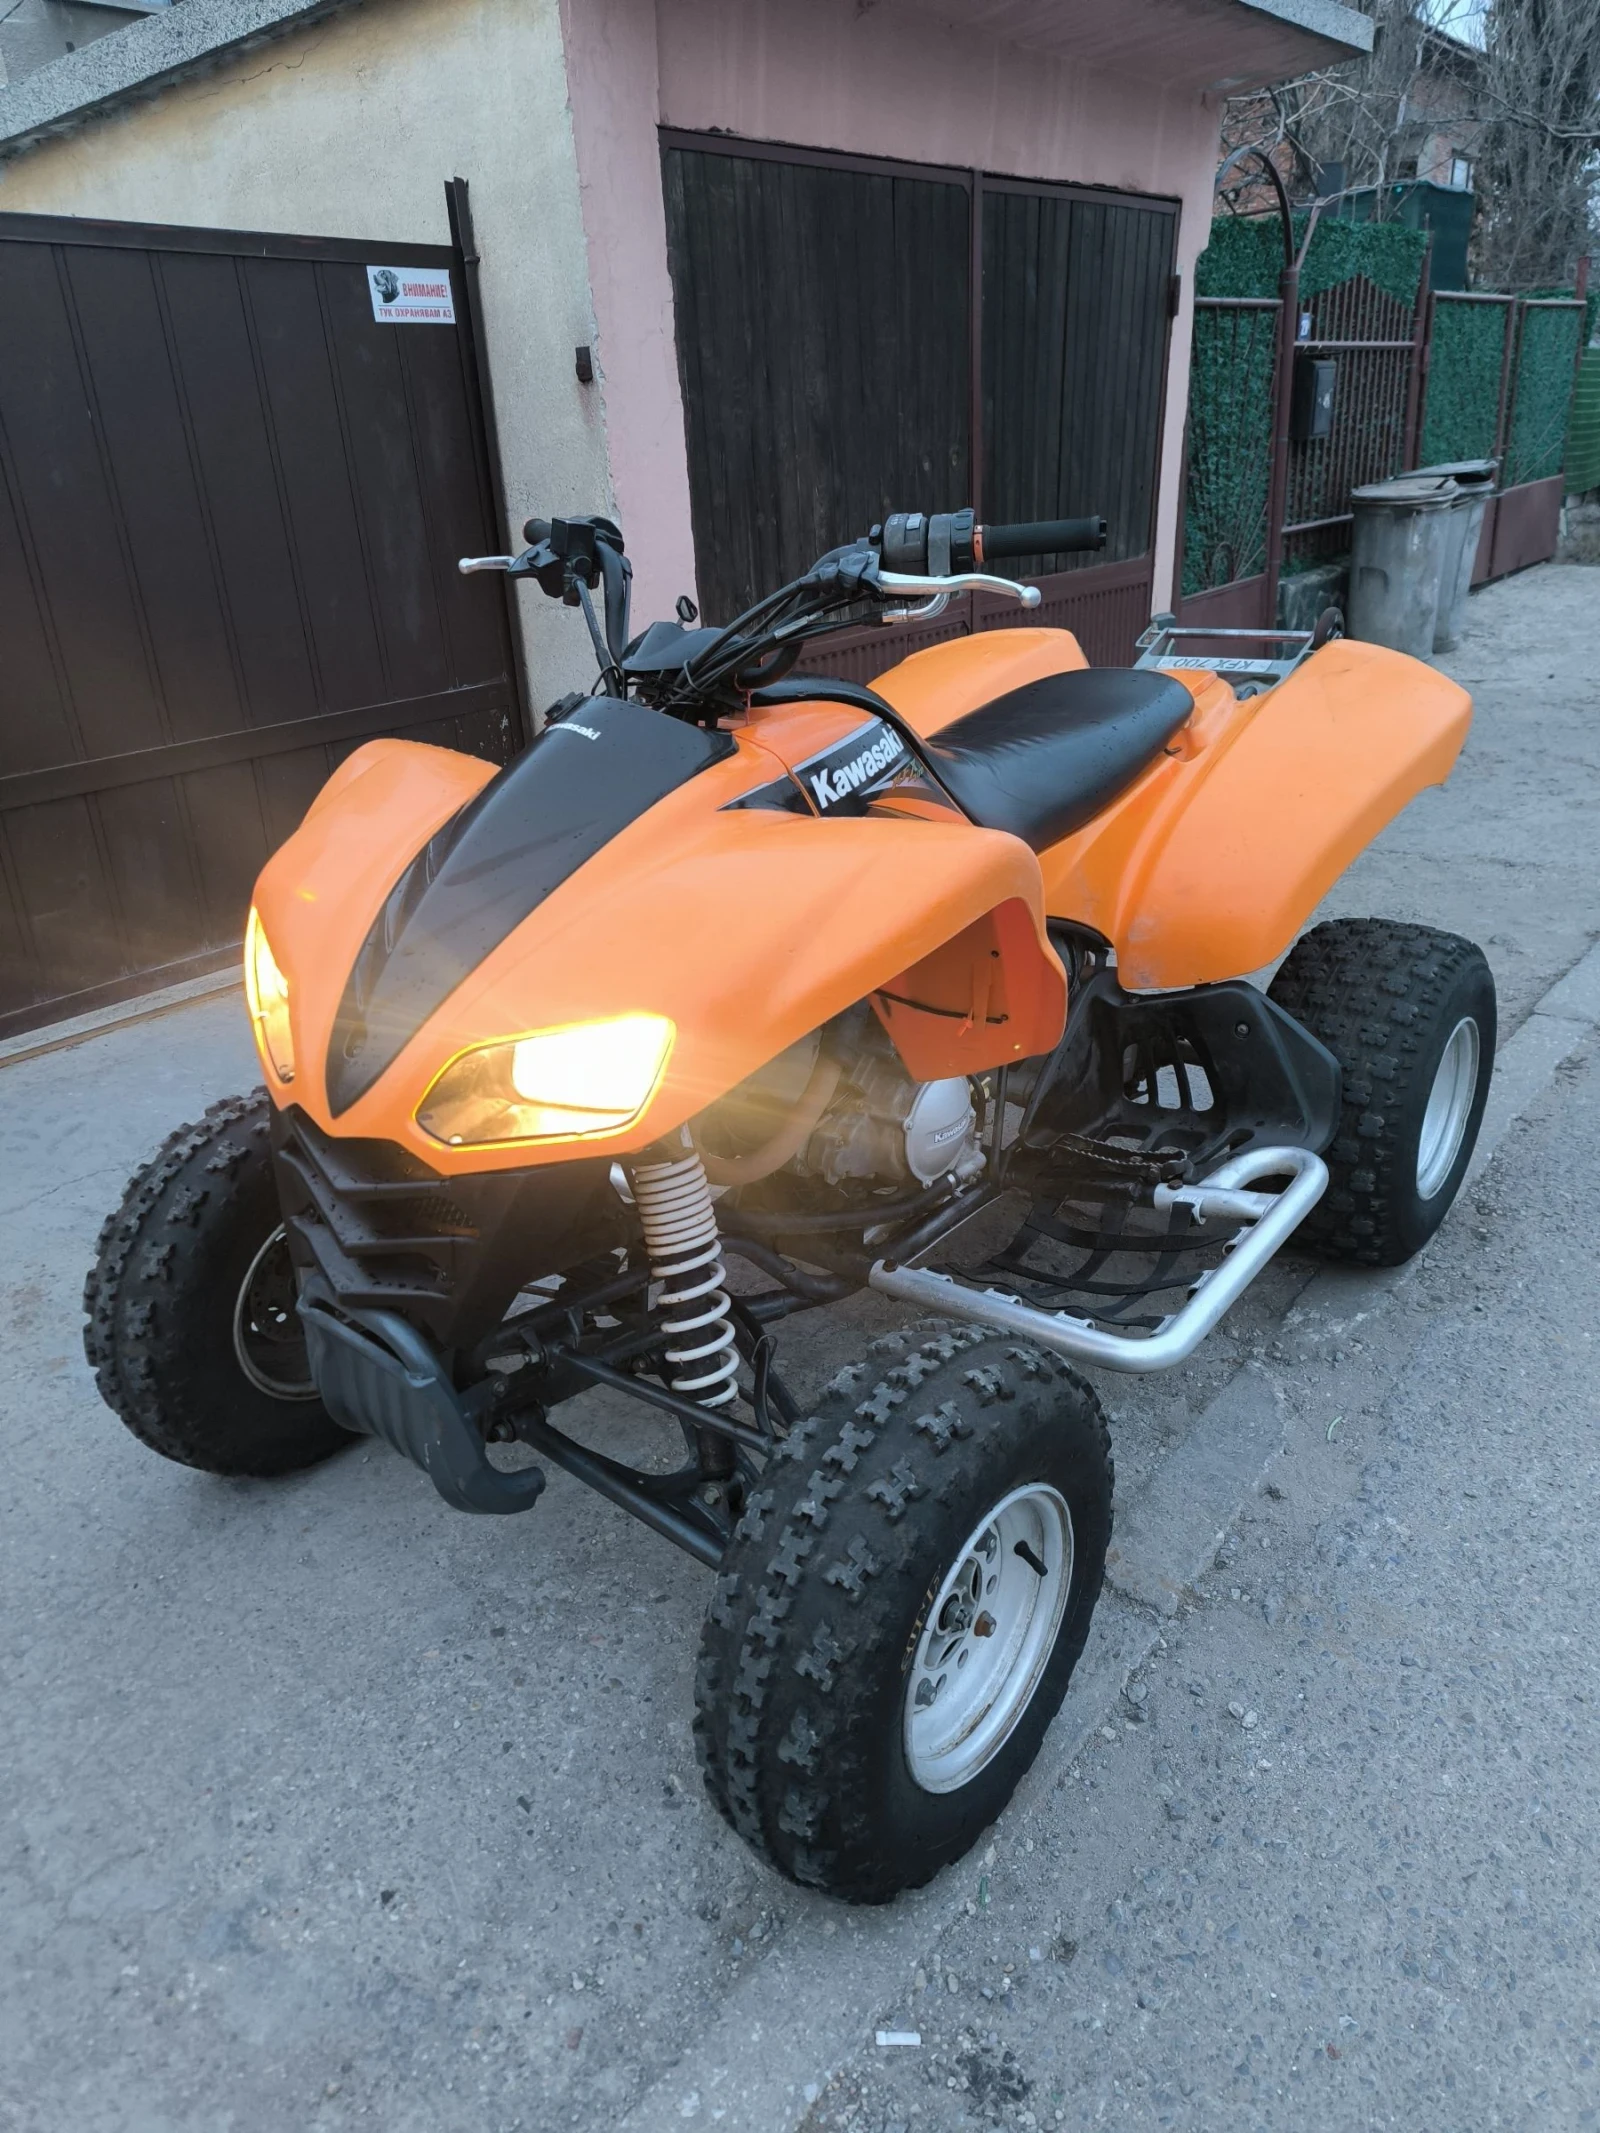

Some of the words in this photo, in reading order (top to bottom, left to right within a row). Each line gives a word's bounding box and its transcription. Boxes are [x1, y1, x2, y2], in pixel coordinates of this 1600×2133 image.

[402, 283, 448, 298] ВНИМАНИЕ!
[379, 308, 394, 317] ТУК
[395, 308, 441, 318] ОХРАНЯВАМ
[442, 310, 452, 318] АЗ
[1173, 658, 1210, 668] 700
[1213, 659, 1255, 670] KFX
[545, 723, 601, 740] wasaki
[810, 723, 904, 809] Kawasaki
